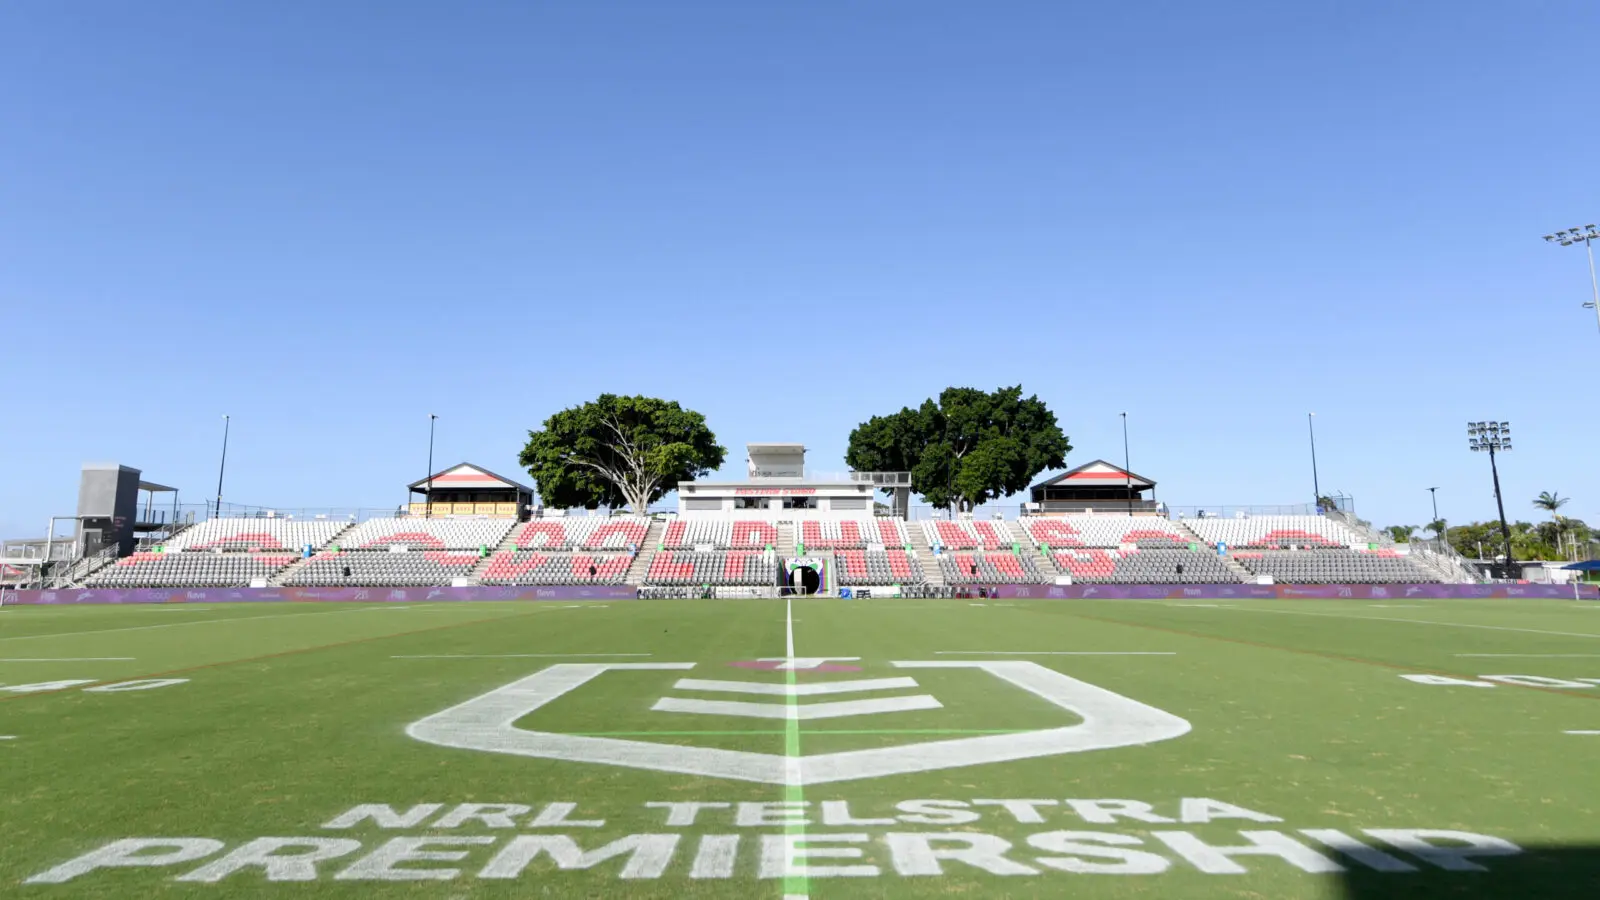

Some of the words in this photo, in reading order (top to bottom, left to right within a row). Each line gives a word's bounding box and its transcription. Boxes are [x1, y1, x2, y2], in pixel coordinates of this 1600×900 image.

[320, 802, 606, 828] NRL
[643, 797, 1284, 828] TELSTRA
[24, 828, 1522, 883] PREMIERSHIP
